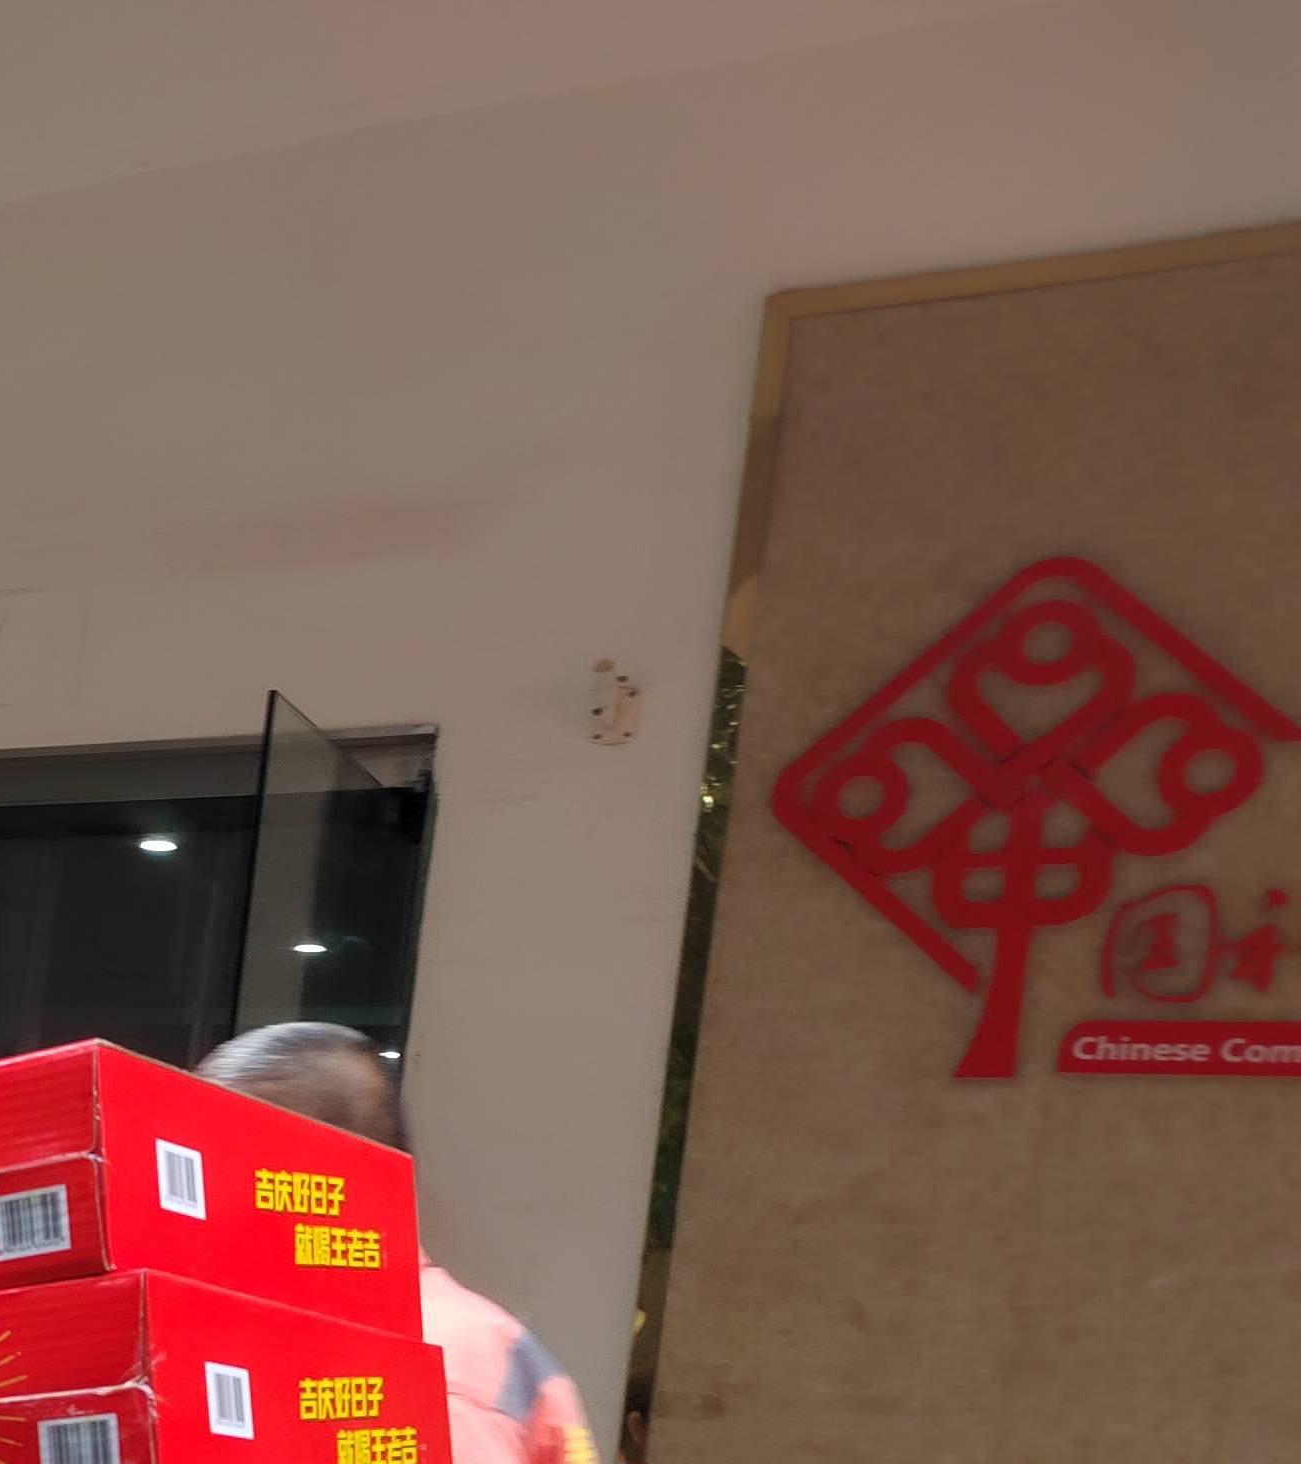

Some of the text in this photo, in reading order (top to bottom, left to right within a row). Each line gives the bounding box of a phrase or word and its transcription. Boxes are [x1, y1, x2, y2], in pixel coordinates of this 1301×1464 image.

[1071, 1035, 1301, 1063] Chinese Com
[254, 1168, 346, 1217] 吉庆好日子
[294, 1223, 382, 1270] 就喝王老吉
[299, 1376, 385, 1421] 吉庆好日子
